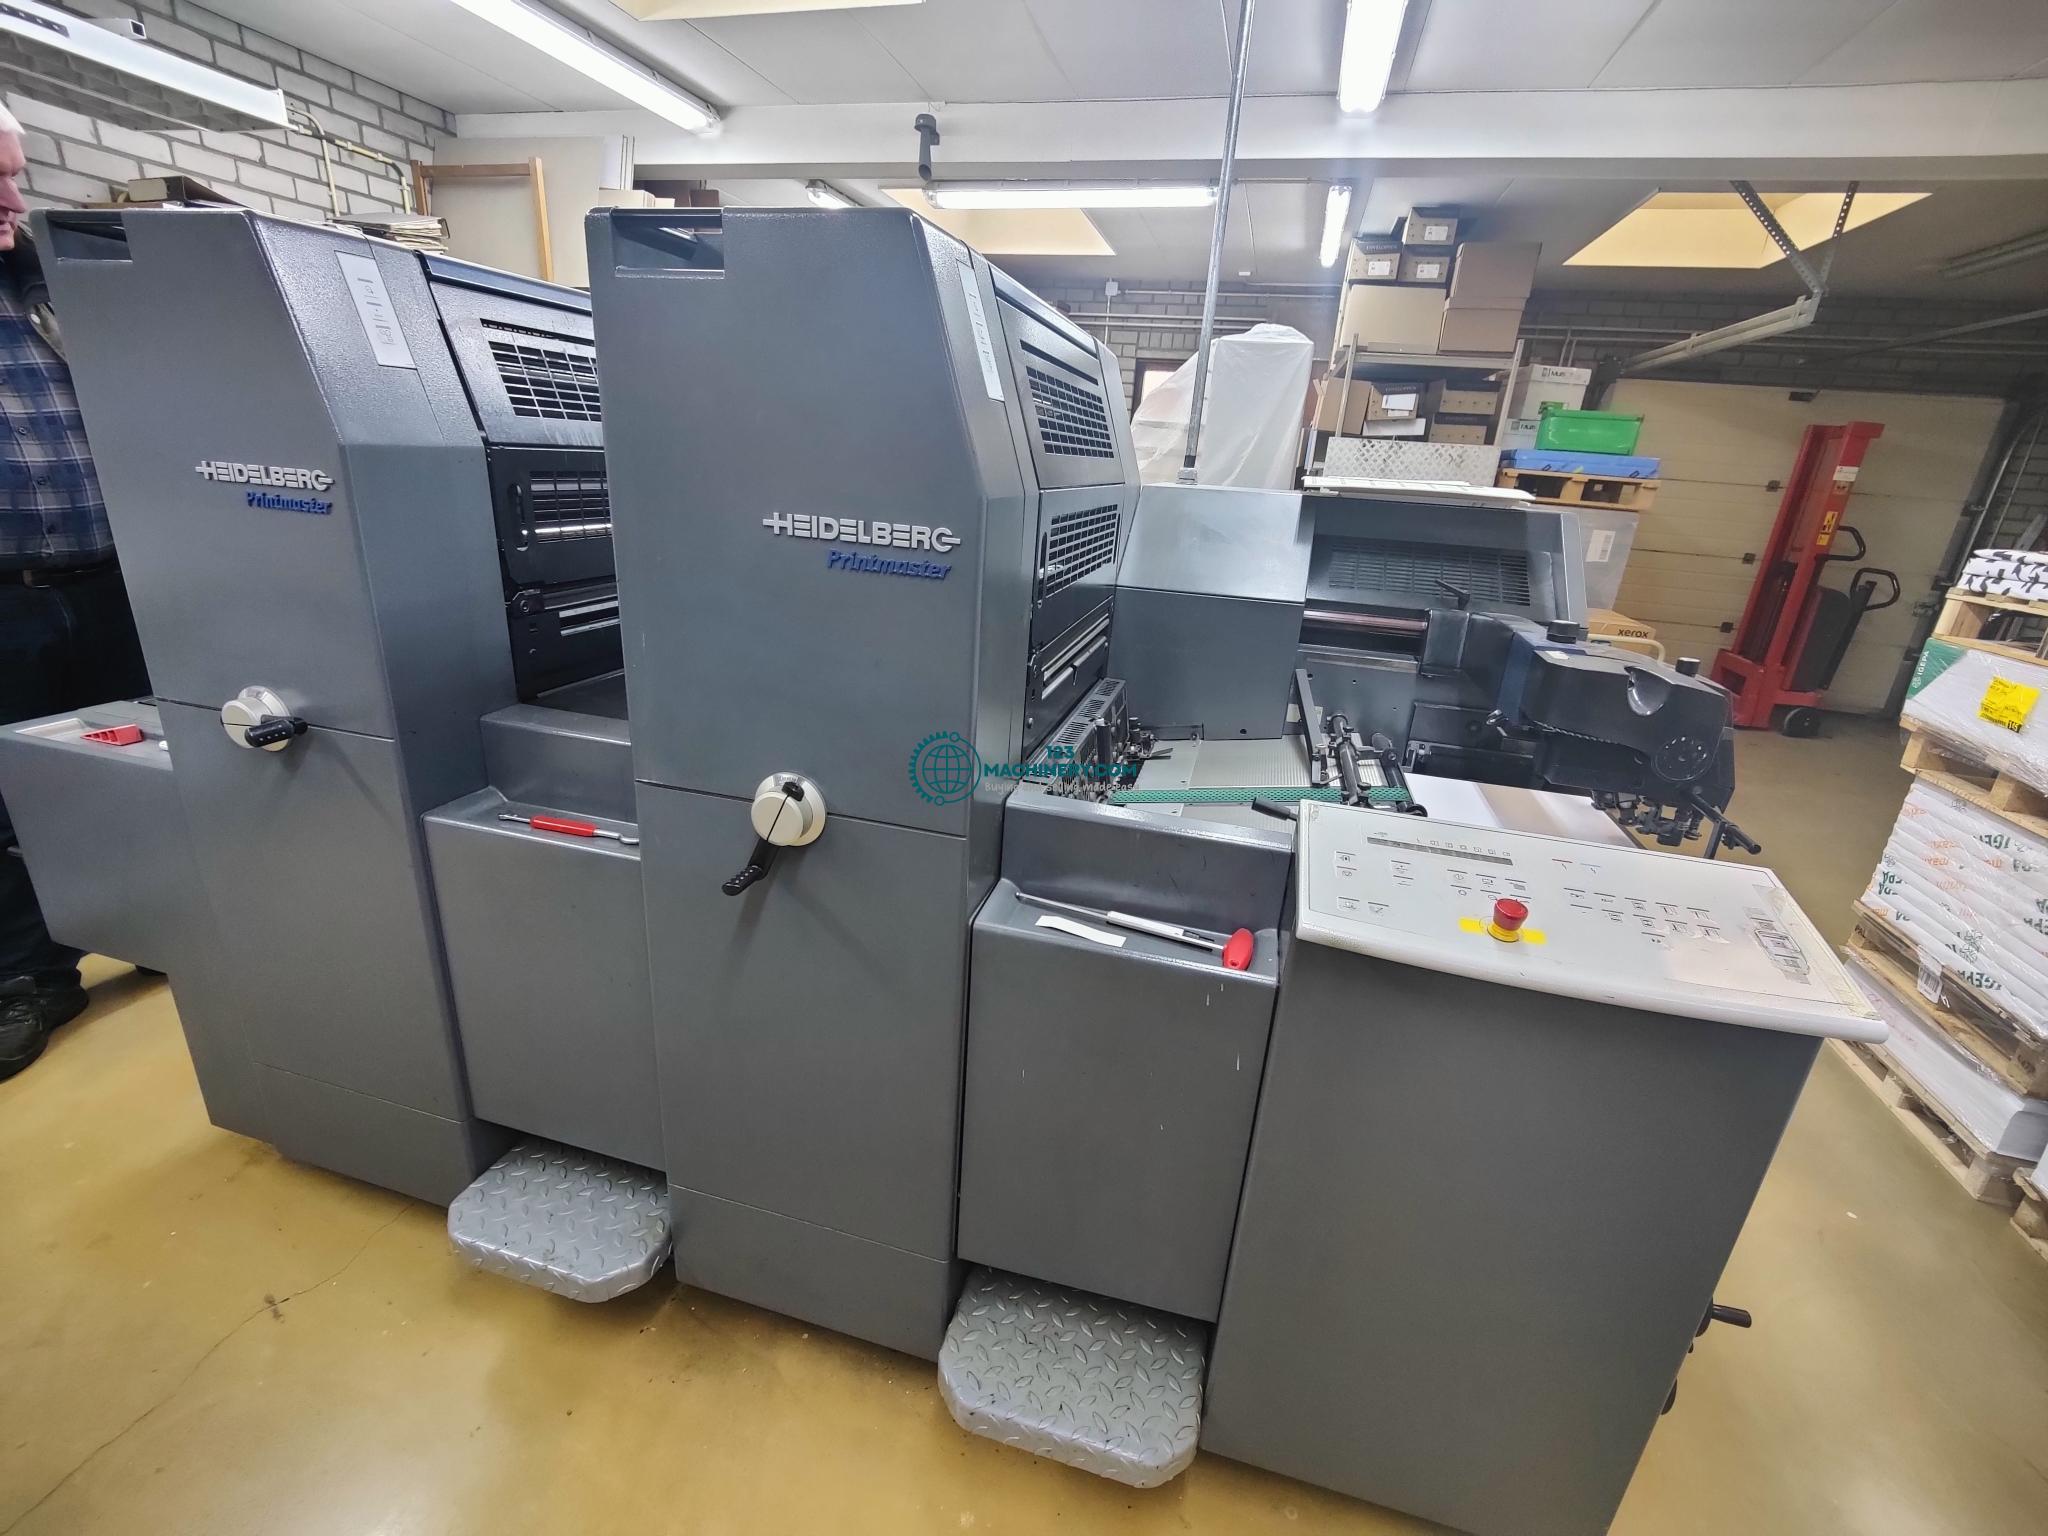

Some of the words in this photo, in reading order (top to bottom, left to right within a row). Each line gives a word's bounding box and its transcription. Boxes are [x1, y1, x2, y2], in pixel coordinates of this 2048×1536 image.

[195, 461, 334, 491] HEIDELBERG
[246, 491, 333, 515] Printmaster
[762, 512, 961, 552] HEIDELBERG
[826, 550, 952, 580] Printmaster
[1617, 629, 1649, 639] xerox
